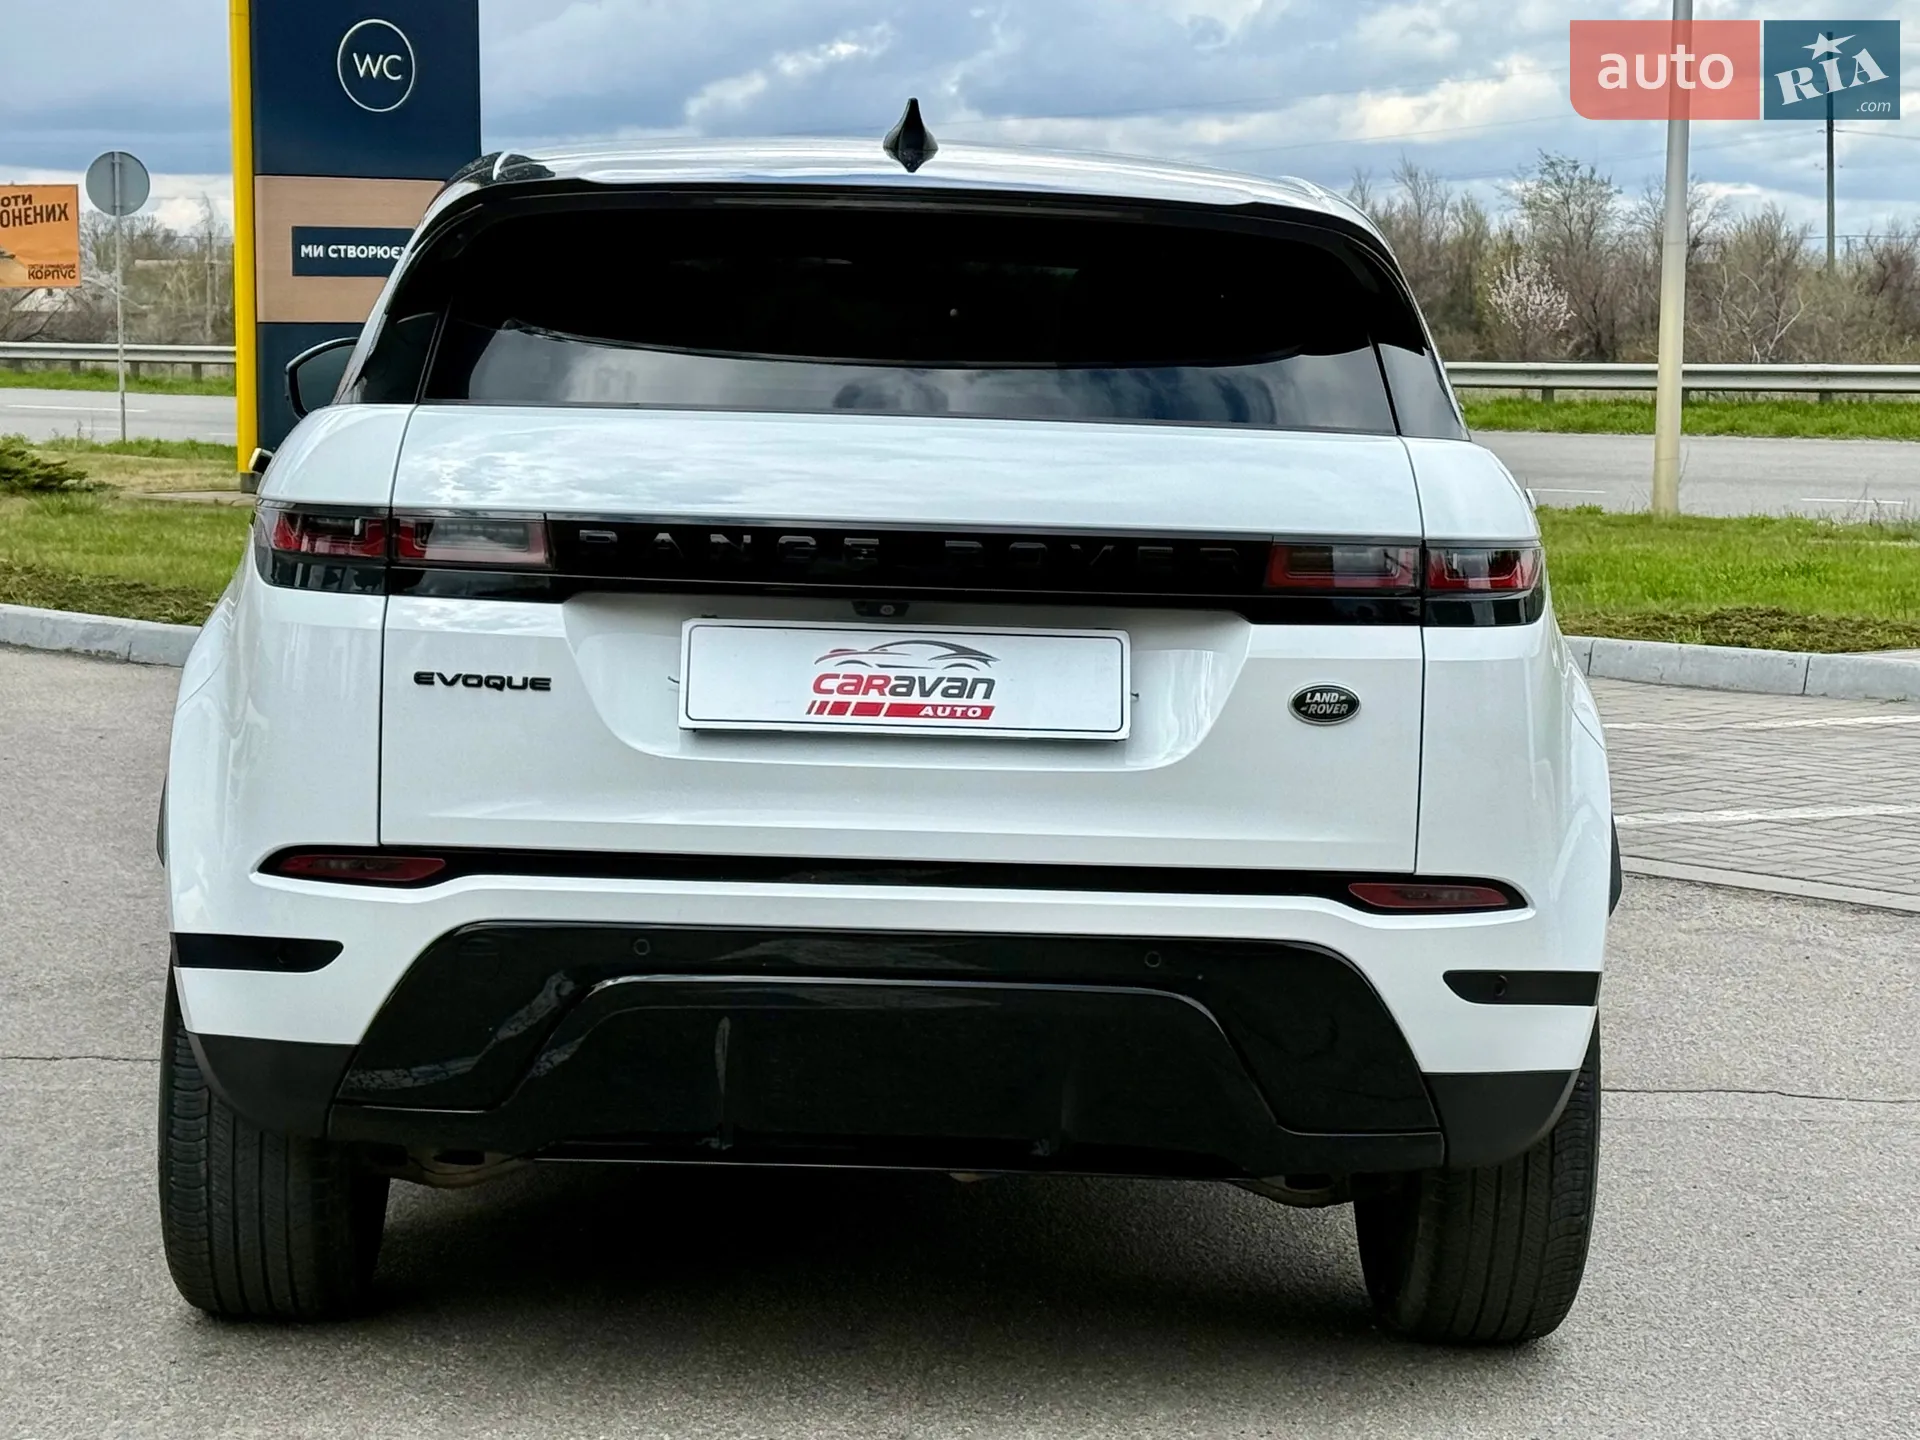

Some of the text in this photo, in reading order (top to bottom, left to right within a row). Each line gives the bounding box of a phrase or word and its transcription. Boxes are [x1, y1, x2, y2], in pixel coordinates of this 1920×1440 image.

[353, 52, 403, 80] WC
[0, 203, 69, 228] ОНЕНИХ
[300, 244, 324, 258] МИ
[28, 269, 76, 280] КОРПУС
[413, 671, 552, 692] EVOQUE
[1305, 692, 1339, 703] LAND
[919, 706, 983, 718] AUTO
[1308, 703, 1348, 714] ROVER
